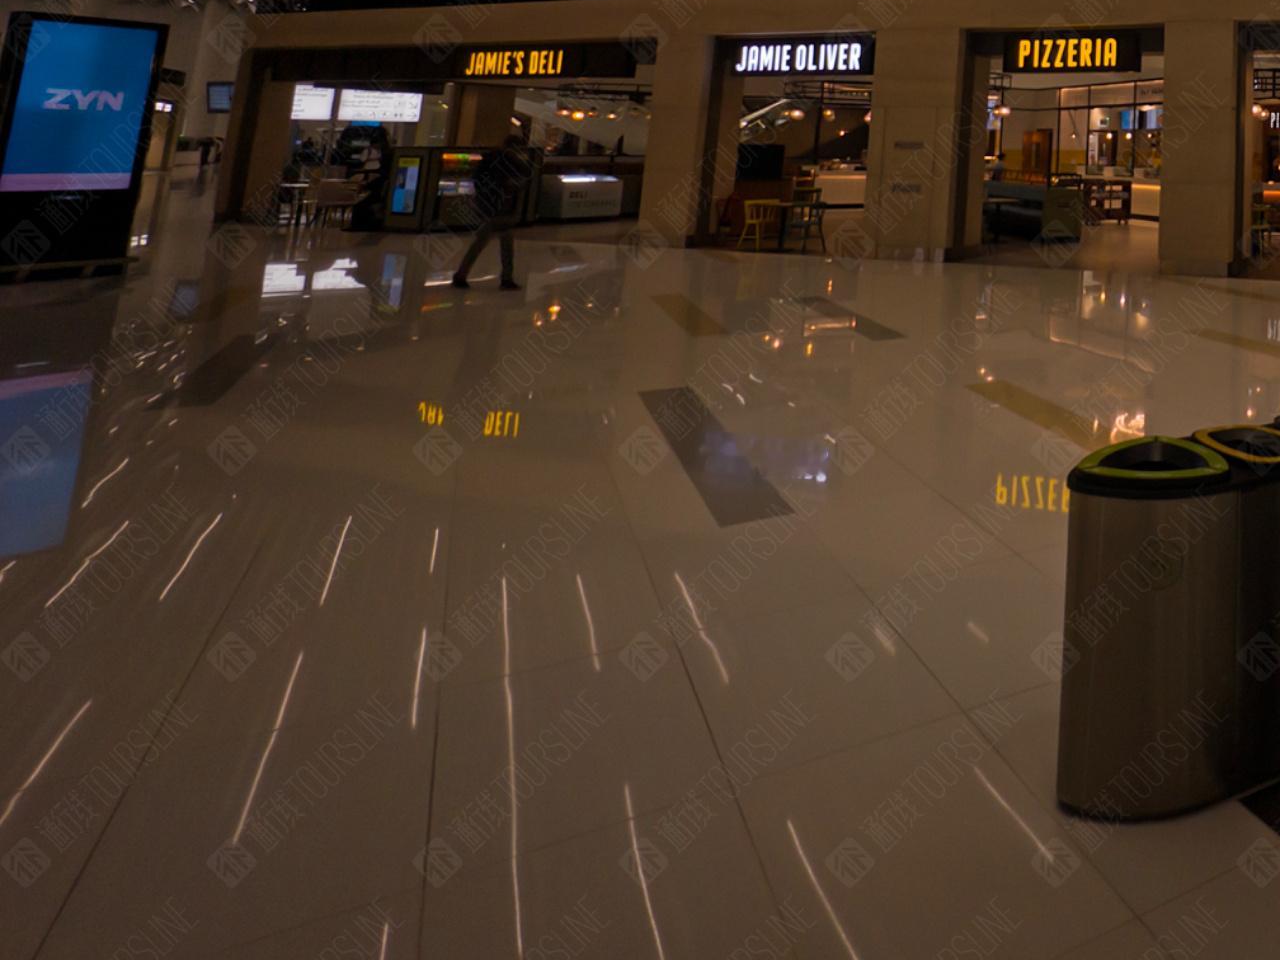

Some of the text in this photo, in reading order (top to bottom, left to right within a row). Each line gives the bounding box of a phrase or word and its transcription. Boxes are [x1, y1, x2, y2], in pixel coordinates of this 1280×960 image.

[465, 49, 564, 76] JAMIE'S DELI
[735, 42, 862, 72] JAMIE OLIVER
[1018, 37, 1118, 68] PIZZERIA
[43, 87, 125, 111] ZYN
